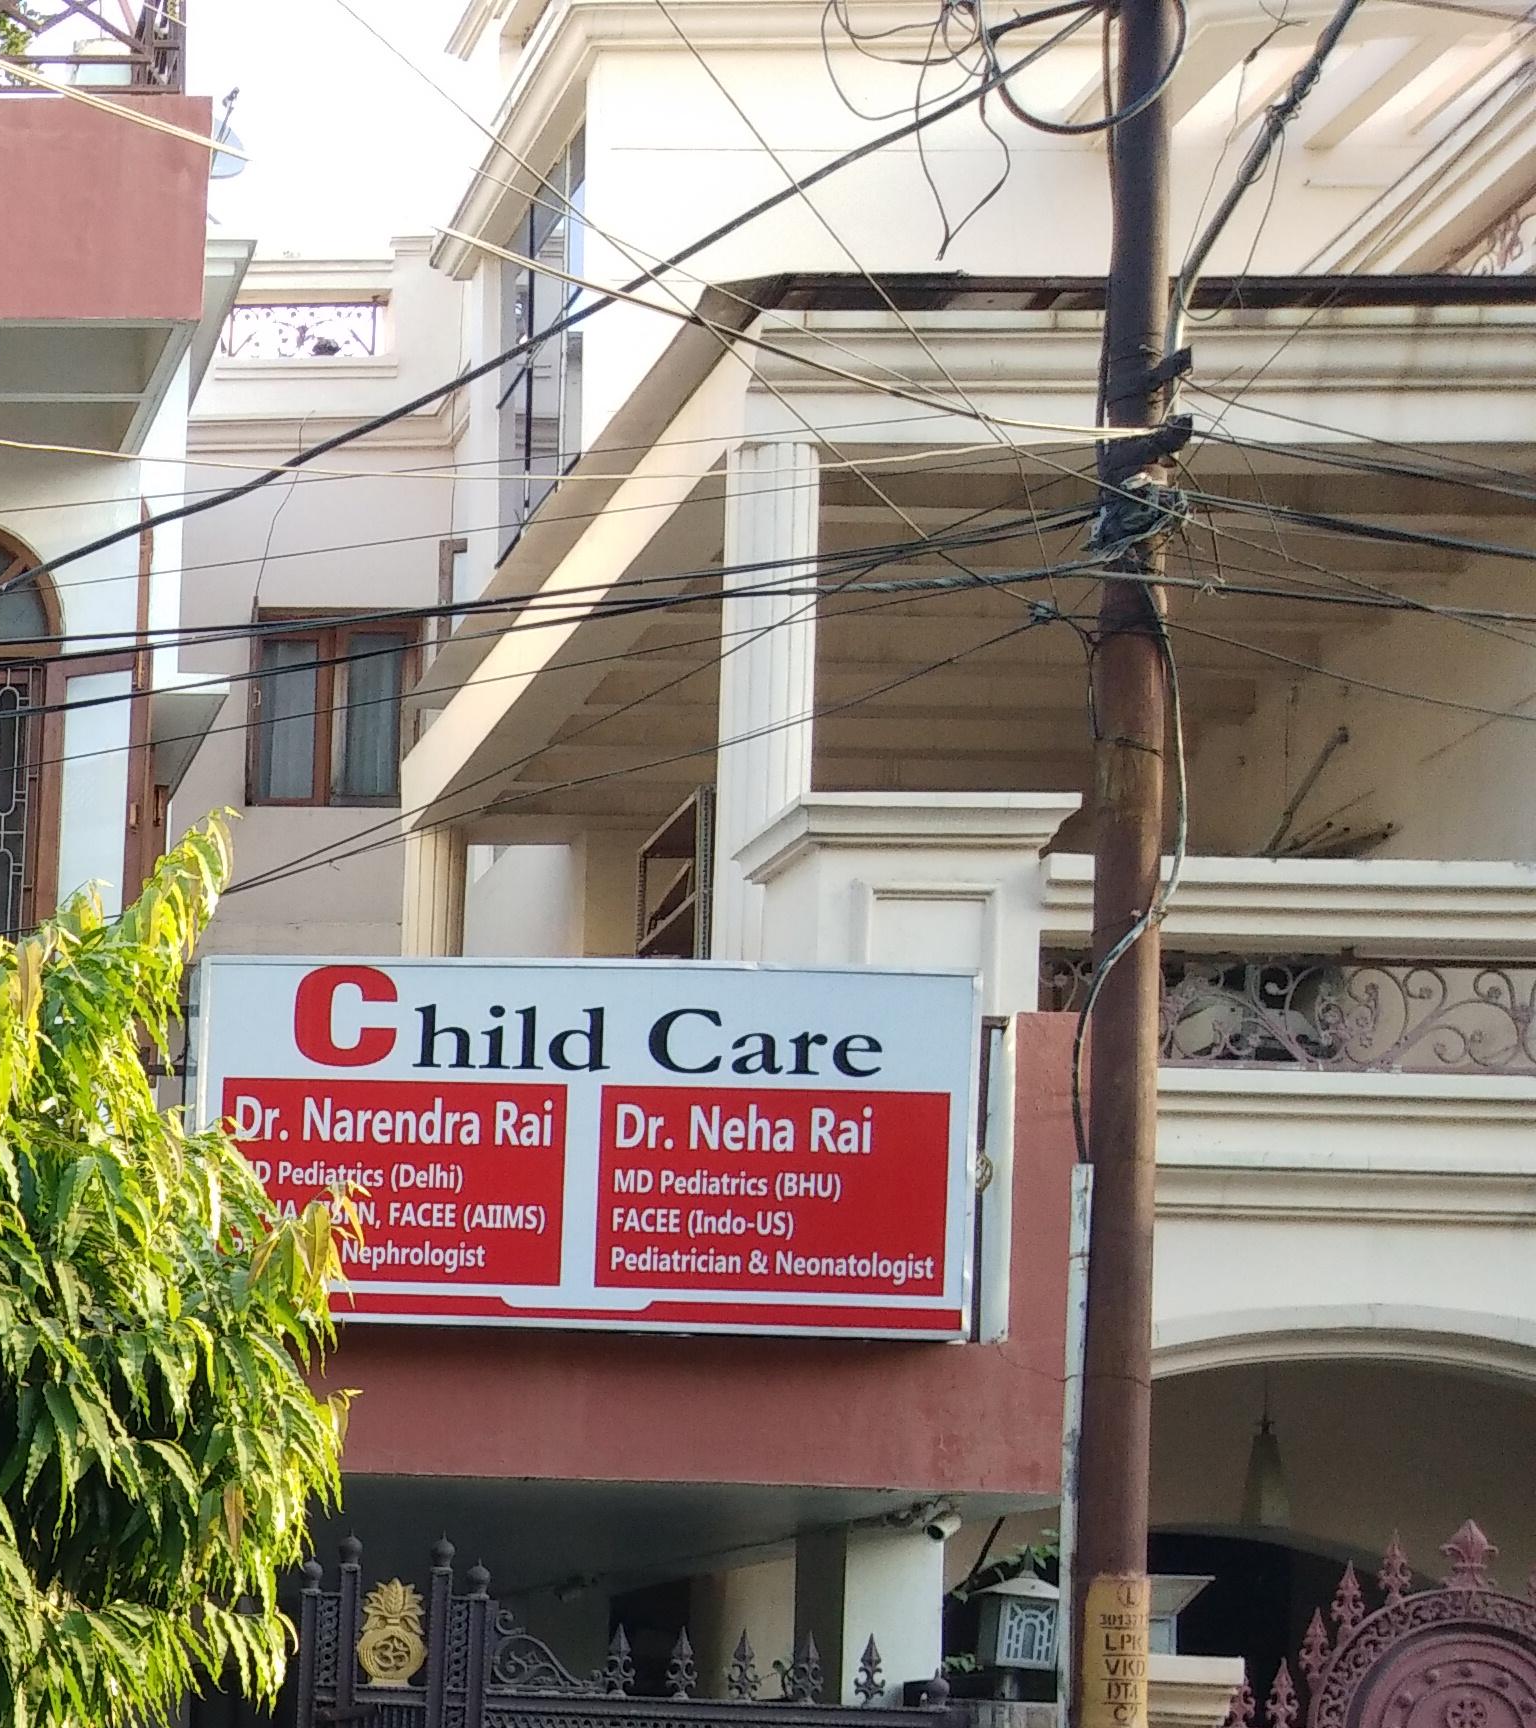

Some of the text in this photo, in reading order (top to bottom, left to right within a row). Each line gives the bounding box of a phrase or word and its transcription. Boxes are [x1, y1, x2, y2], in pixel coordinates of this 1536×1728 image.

[294, 965, 882, 1077] Child Care
[235, 1095, 553, 1147] Dr. Narendra Rai
[615, 1103, 873, 1154] Dr. Neha Rai
[278, 1160, 384, 1187] Pediatrics
[391, 1163, 464, 1194] (Delhi)
[614, 1168, 842, 1202] MD Pediatrics (BHU)
[389, 1202, 456, 1227] FACEE
[464, 1204, 546, 1234] (AIIMS)
[612, 1207, 794, 1240] FACEE (Indo-US)
[342, 1239, 486, 1274] Nephrologist
[611, 1246, 935, 1286] Pediatrician & Neonatologist
